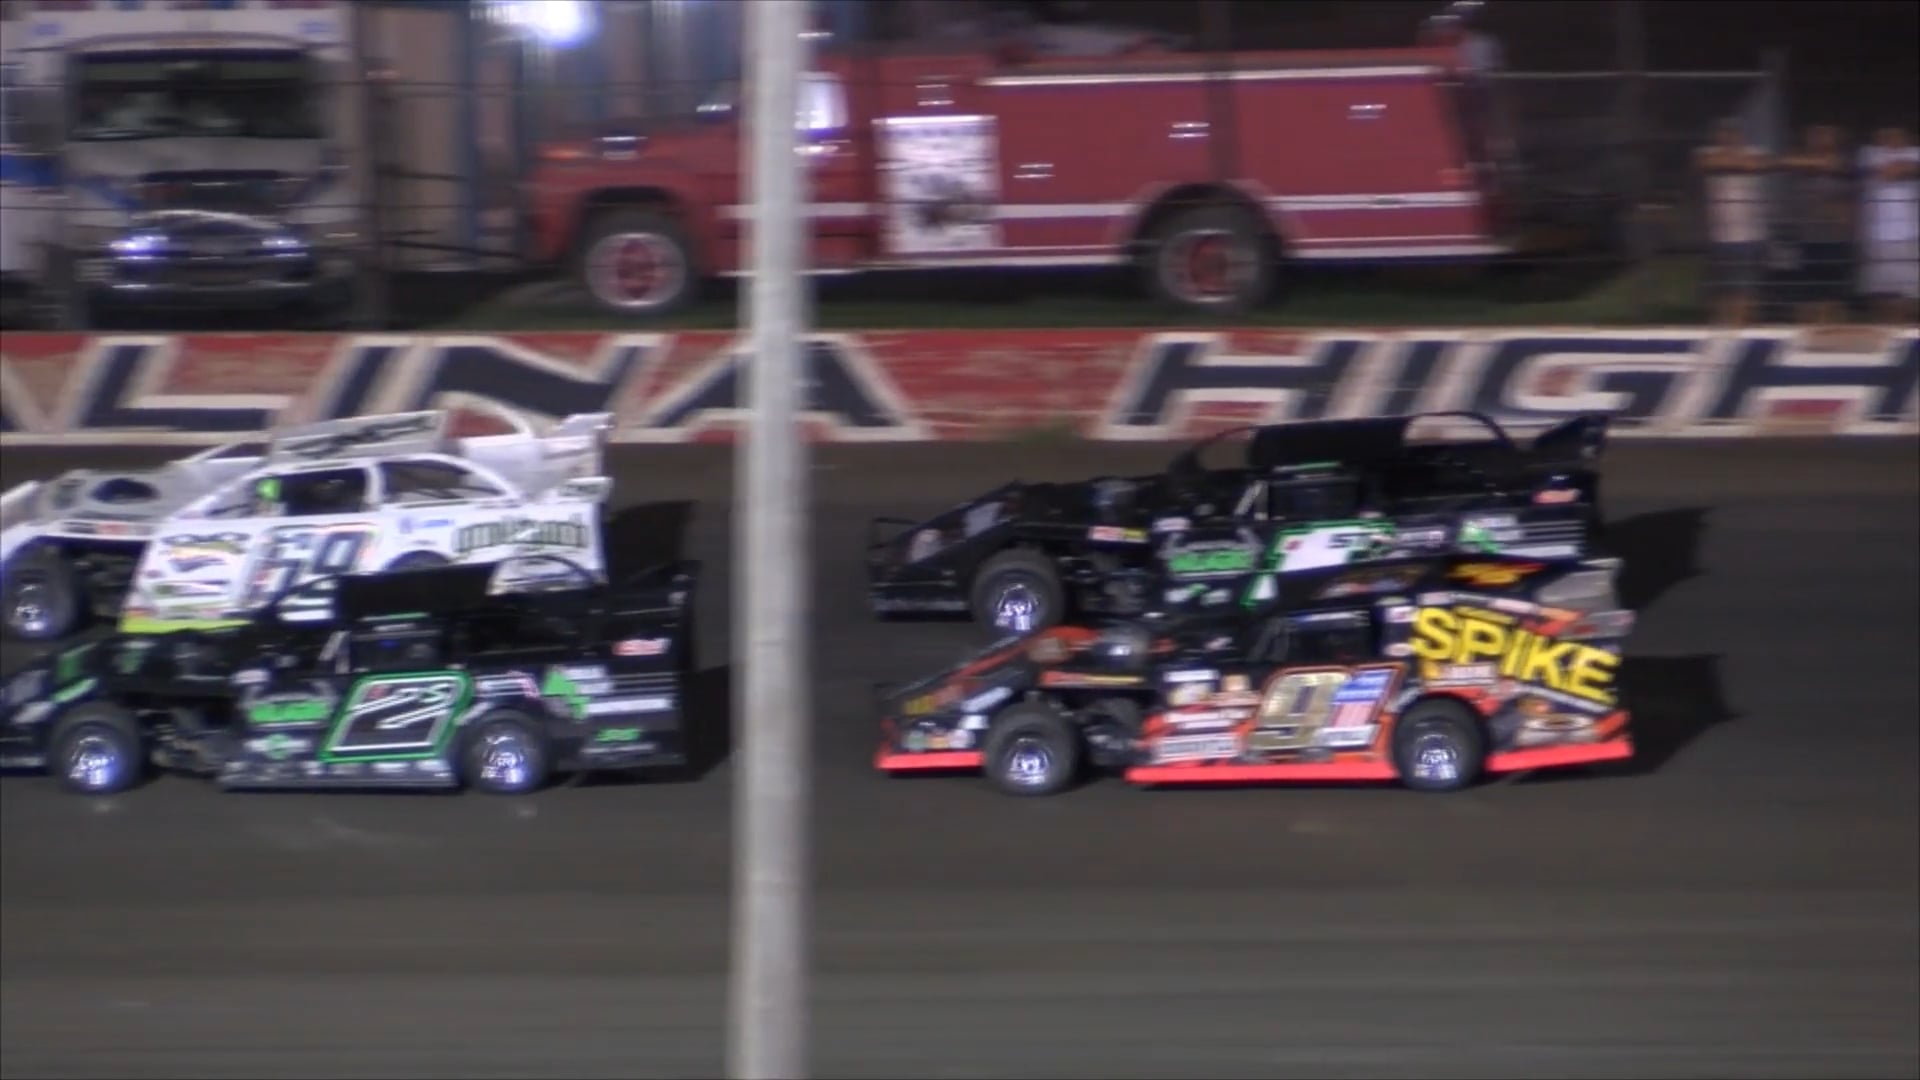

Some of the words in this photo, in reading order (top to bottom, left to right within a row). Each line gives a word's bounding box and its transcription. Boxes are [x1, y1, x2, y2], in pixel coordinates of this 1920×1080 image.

[0, 335, 930, 443] LINA
[1093, 333, 1920, 440] HIGH
[1408, 607, 1622, 706] SPIKE
